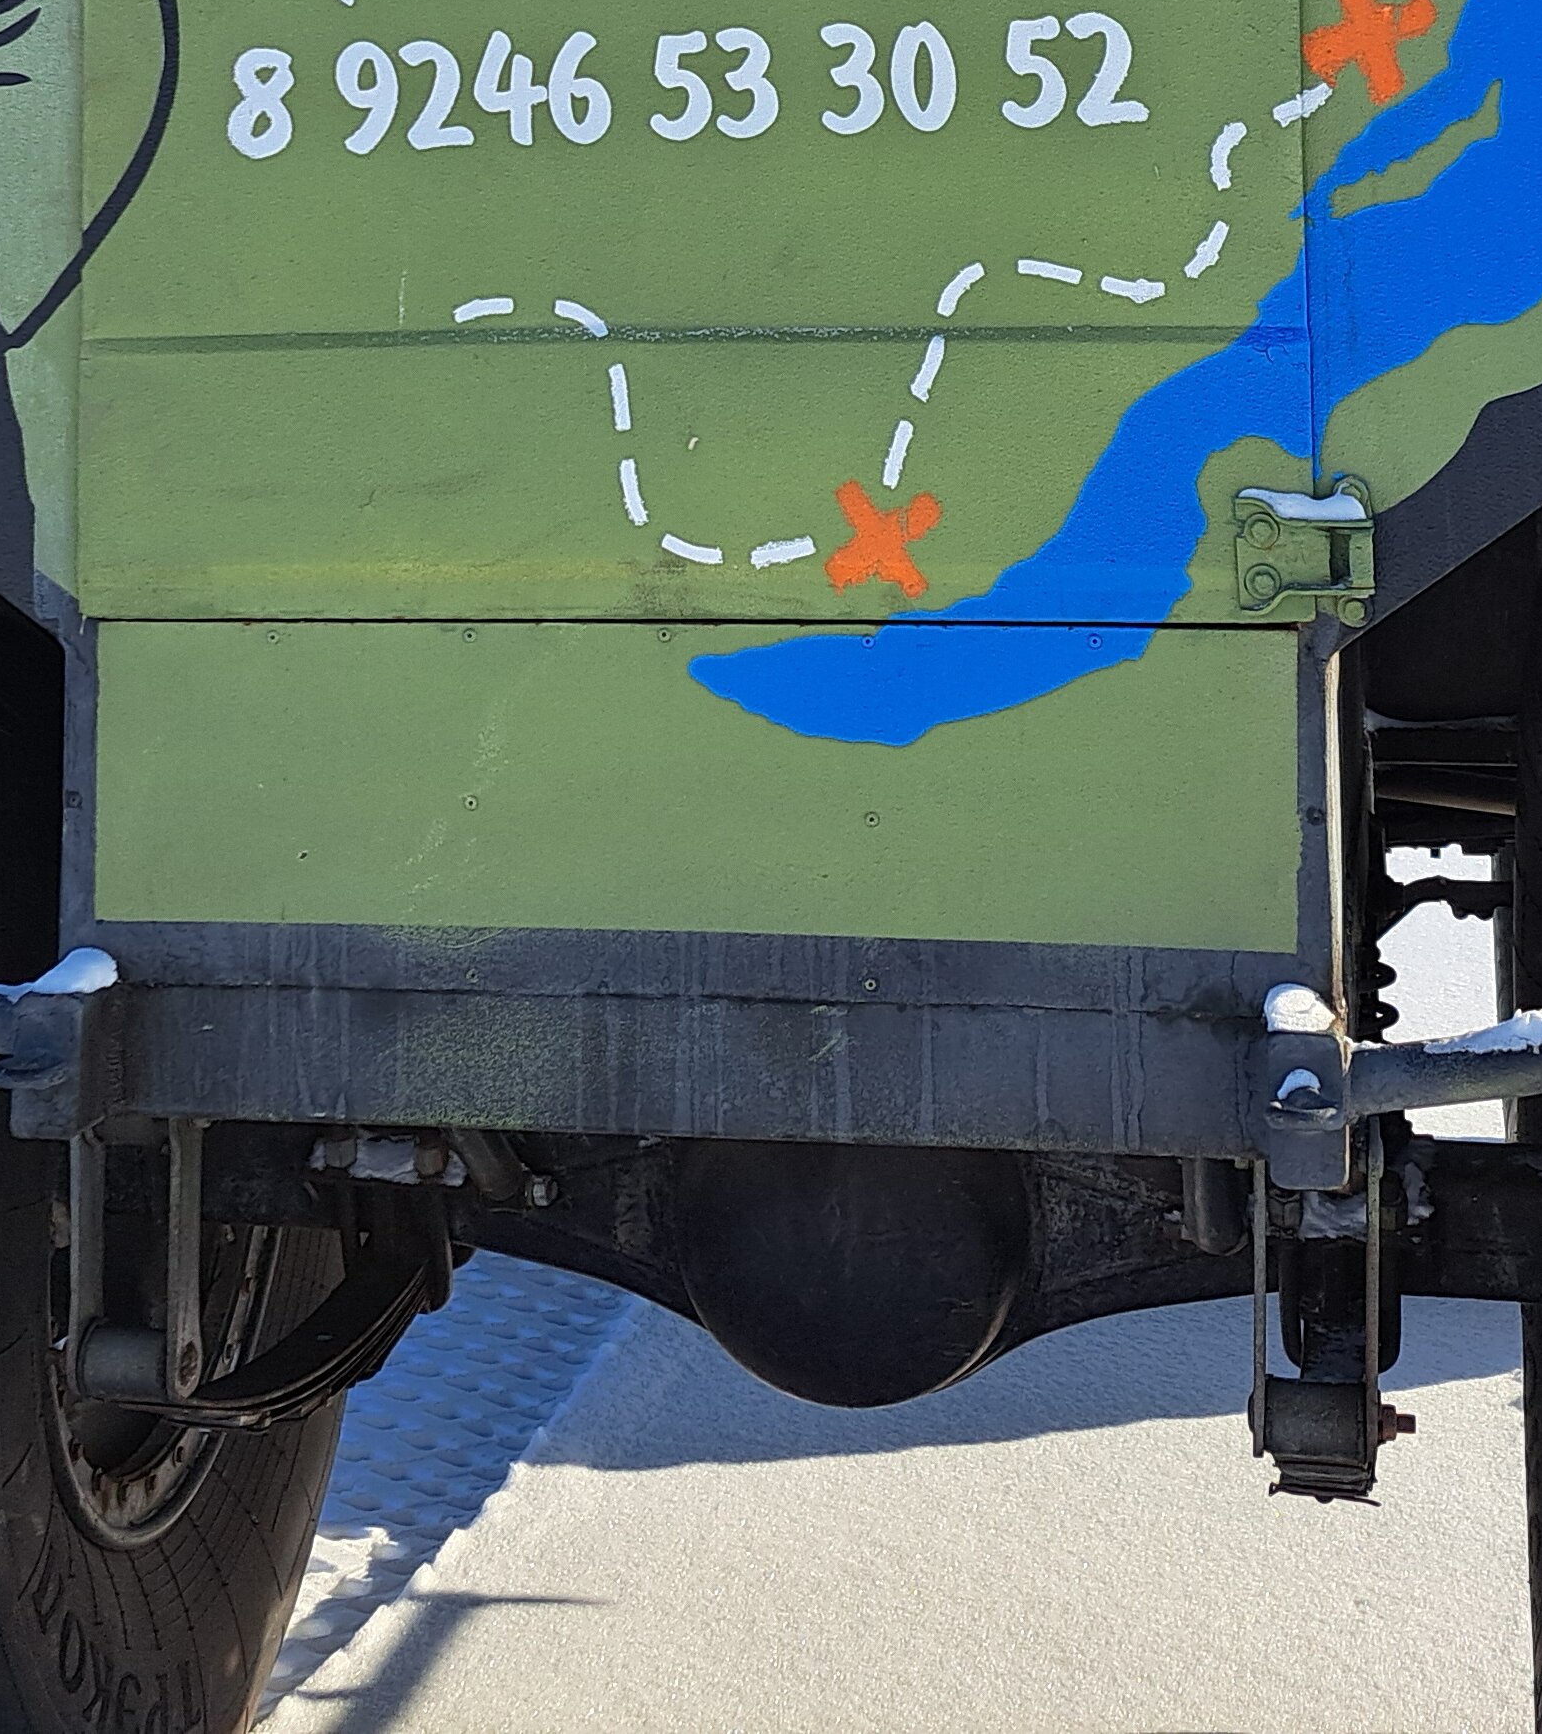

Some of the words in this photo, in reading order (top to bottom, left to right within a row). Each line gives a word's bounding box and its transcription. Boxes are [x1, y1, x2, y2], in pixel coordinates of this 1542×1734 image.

[226, 46, 296, 160] 8
[334, 29, 612, 155] 9246
[648, 26, 780, 142] 53
[819, 19, 957, 135] 30
[1000, 11, 1149, 129] 52
